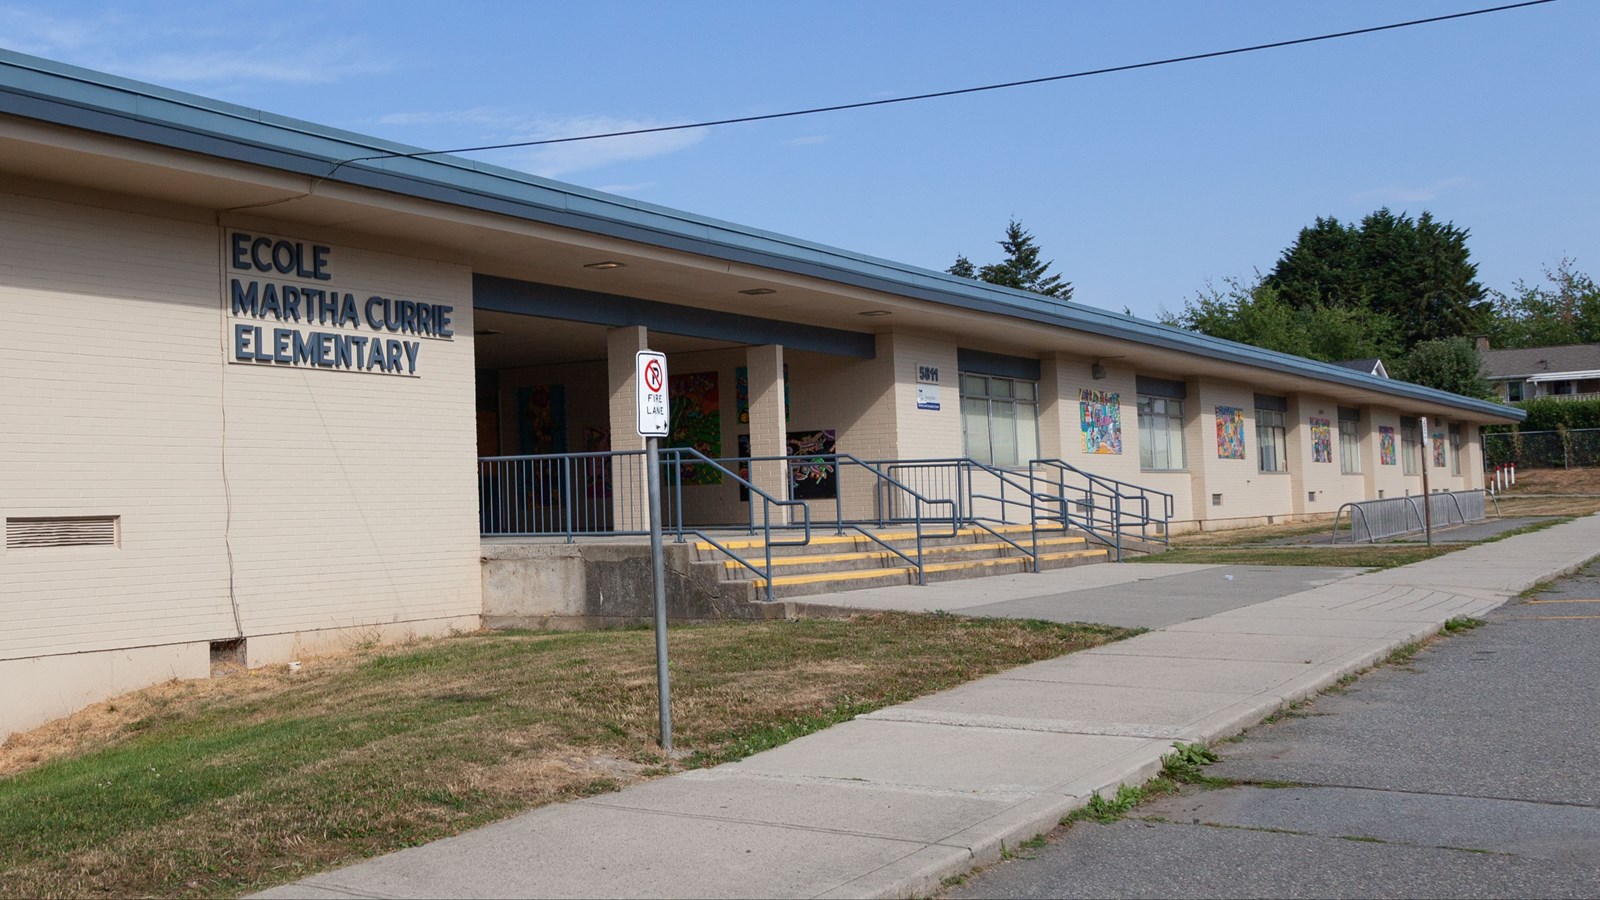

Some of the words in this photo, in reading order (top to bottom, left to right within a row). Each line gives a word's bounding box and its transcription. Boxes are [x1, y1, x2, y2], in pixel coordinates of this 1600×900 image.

[232, 232, 331, 280] ECOLE
[231, 279, 360, 328] MARTHA
[365, 296, 454, 337] CURRIE
[235, 323, 420, 374] ELEMENTARY
[919, 366, 939, 382] 5811
[646, 406, 664, 416] LANE
[647, 393, 663, 404] FIRE
